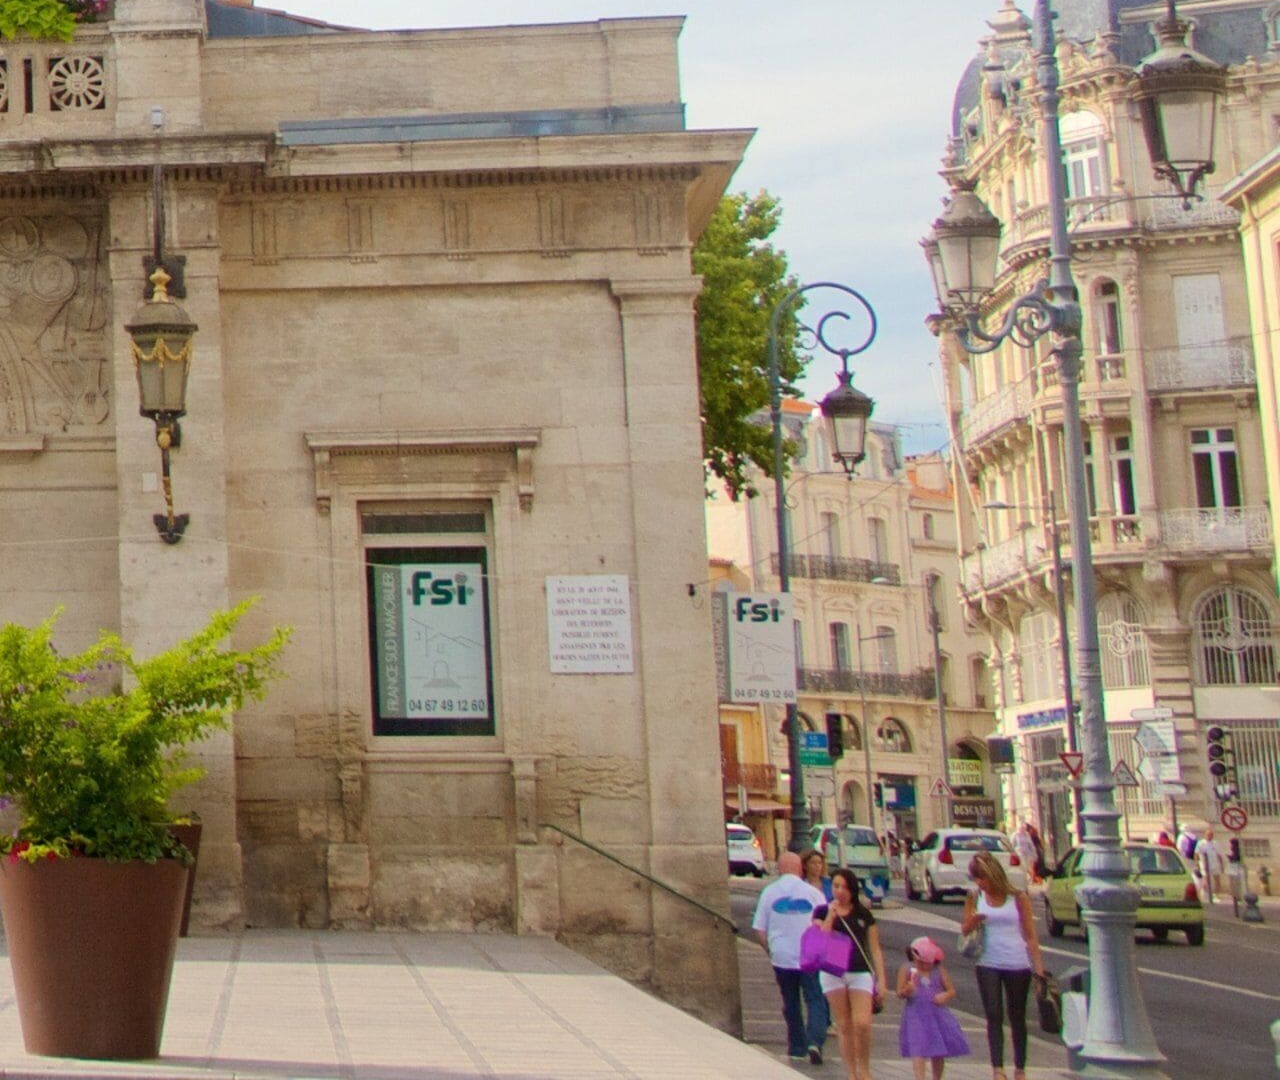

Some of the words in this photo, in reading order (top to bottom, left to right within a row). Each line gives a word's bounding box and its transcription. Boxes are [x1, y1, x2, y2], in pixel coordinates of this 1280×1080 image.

[734, 689, 745, 698] 04
[409, 700, 422, 712] 04
[424, 700, 438, 712] 67
[441, 699, 454, 712] 49
[457, 699, 468, 712] 12
[471, 699, 485, 712] 60
